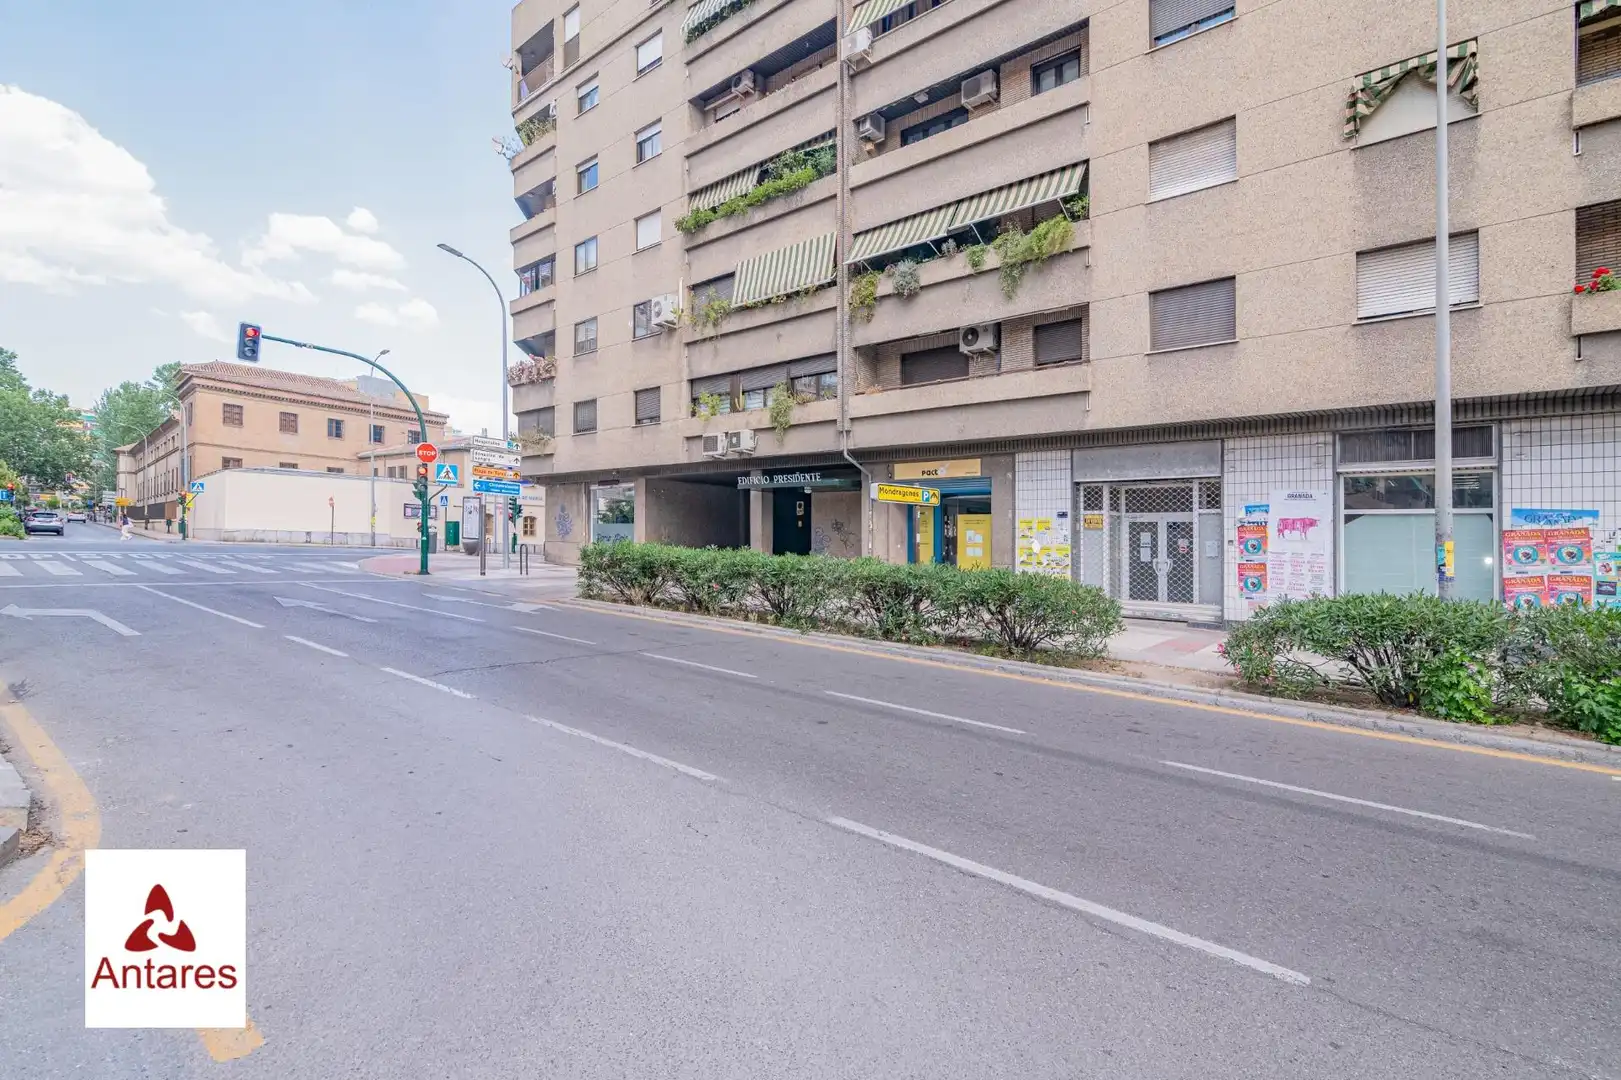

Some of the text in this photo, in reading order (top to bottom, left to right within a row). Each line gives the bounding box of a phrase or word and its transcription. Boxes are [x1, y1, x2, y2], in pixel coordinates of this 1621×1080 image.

[737, 472, 821, 485] EDIFICIO PRESIDENTE
[921, 468, 938, 477] pact
[879, 486, 919, 498] Mondragones
